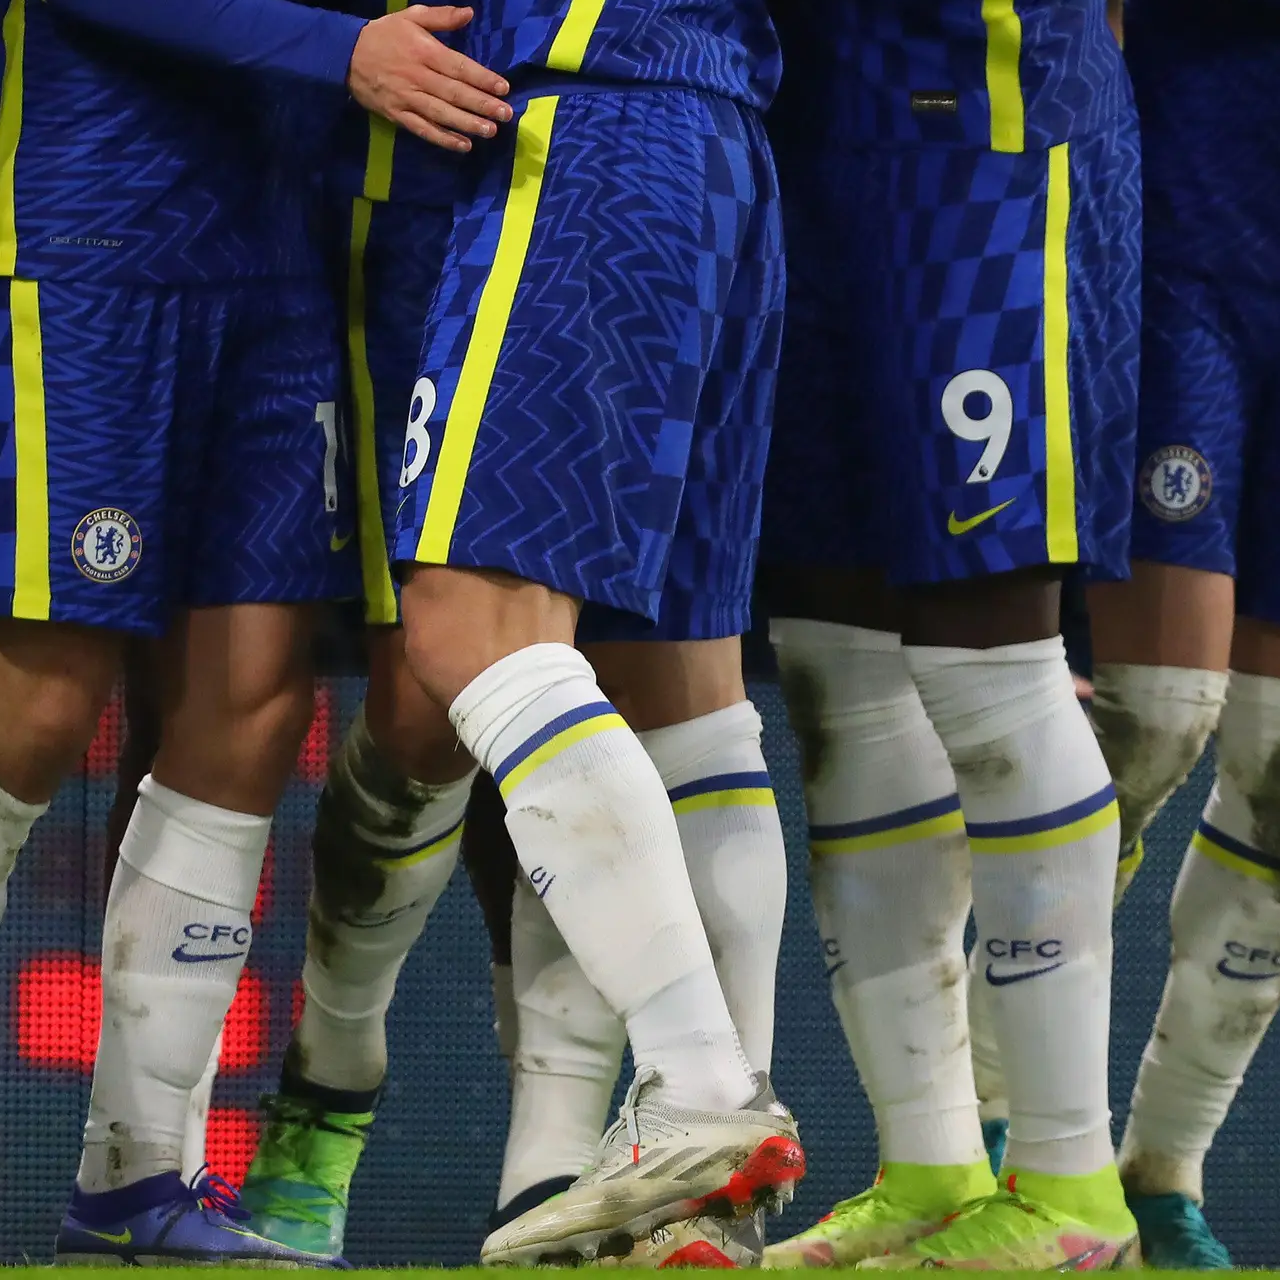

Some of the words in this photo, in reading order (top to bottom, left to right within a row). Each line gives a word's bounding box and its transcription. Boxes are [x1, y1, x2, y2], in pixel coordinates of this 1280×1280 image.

[940, 368, 1014, 484] 9
[315, 401, 347, 512] 1
[86, 510, 131, 529] CHELSEA
[82, 563, 112, 579] FOOTBALL
[114, 565, 129, 577] CLUB
[183, 923, 249, 946] CFC
[985, 938, 1062, 959] CFC
